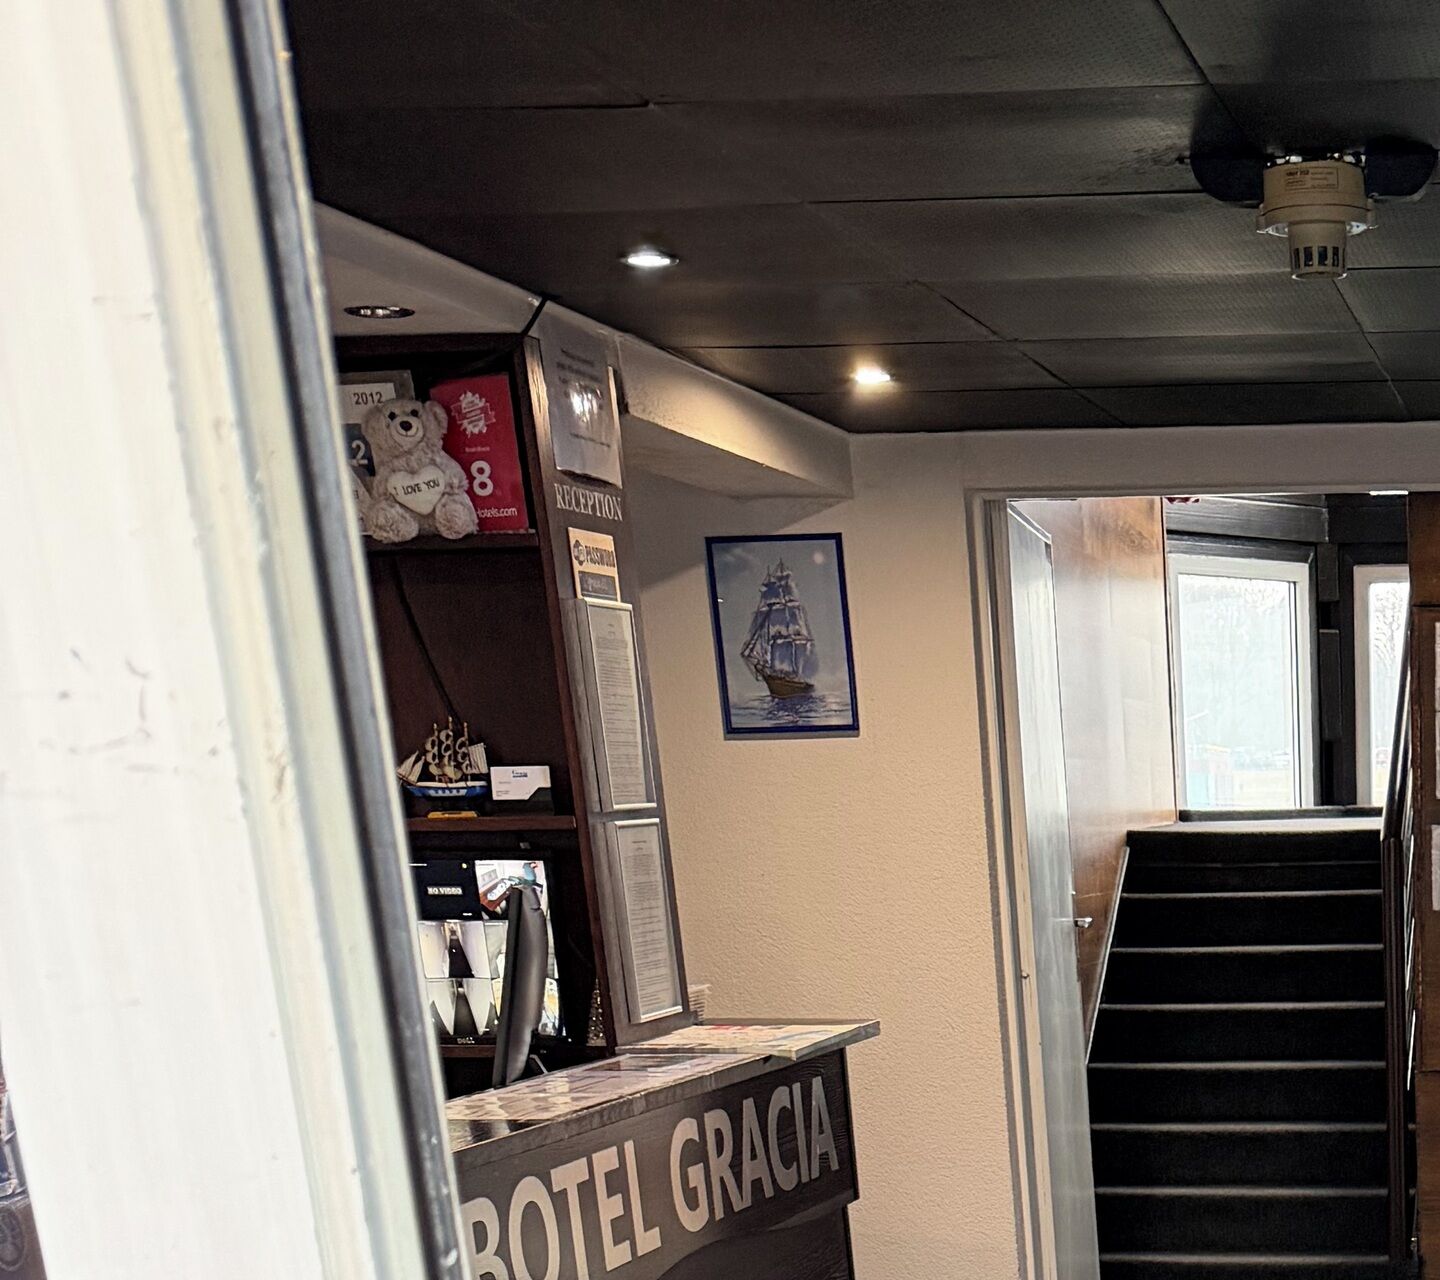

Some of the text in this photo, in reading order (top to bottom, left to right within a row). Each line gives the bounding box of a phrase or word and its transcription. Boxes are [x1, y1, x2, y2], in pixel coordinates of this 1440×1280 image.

[353, 391, 383, 406] 2012
[403, 483, 421, 496] LOVE
[423, 479, 440, 492] YOU
[470, 460, 494, 497] 8
[554, 483, 623, 522] RECEPTION
[669, 1076, 839, 1233] GRACIA
